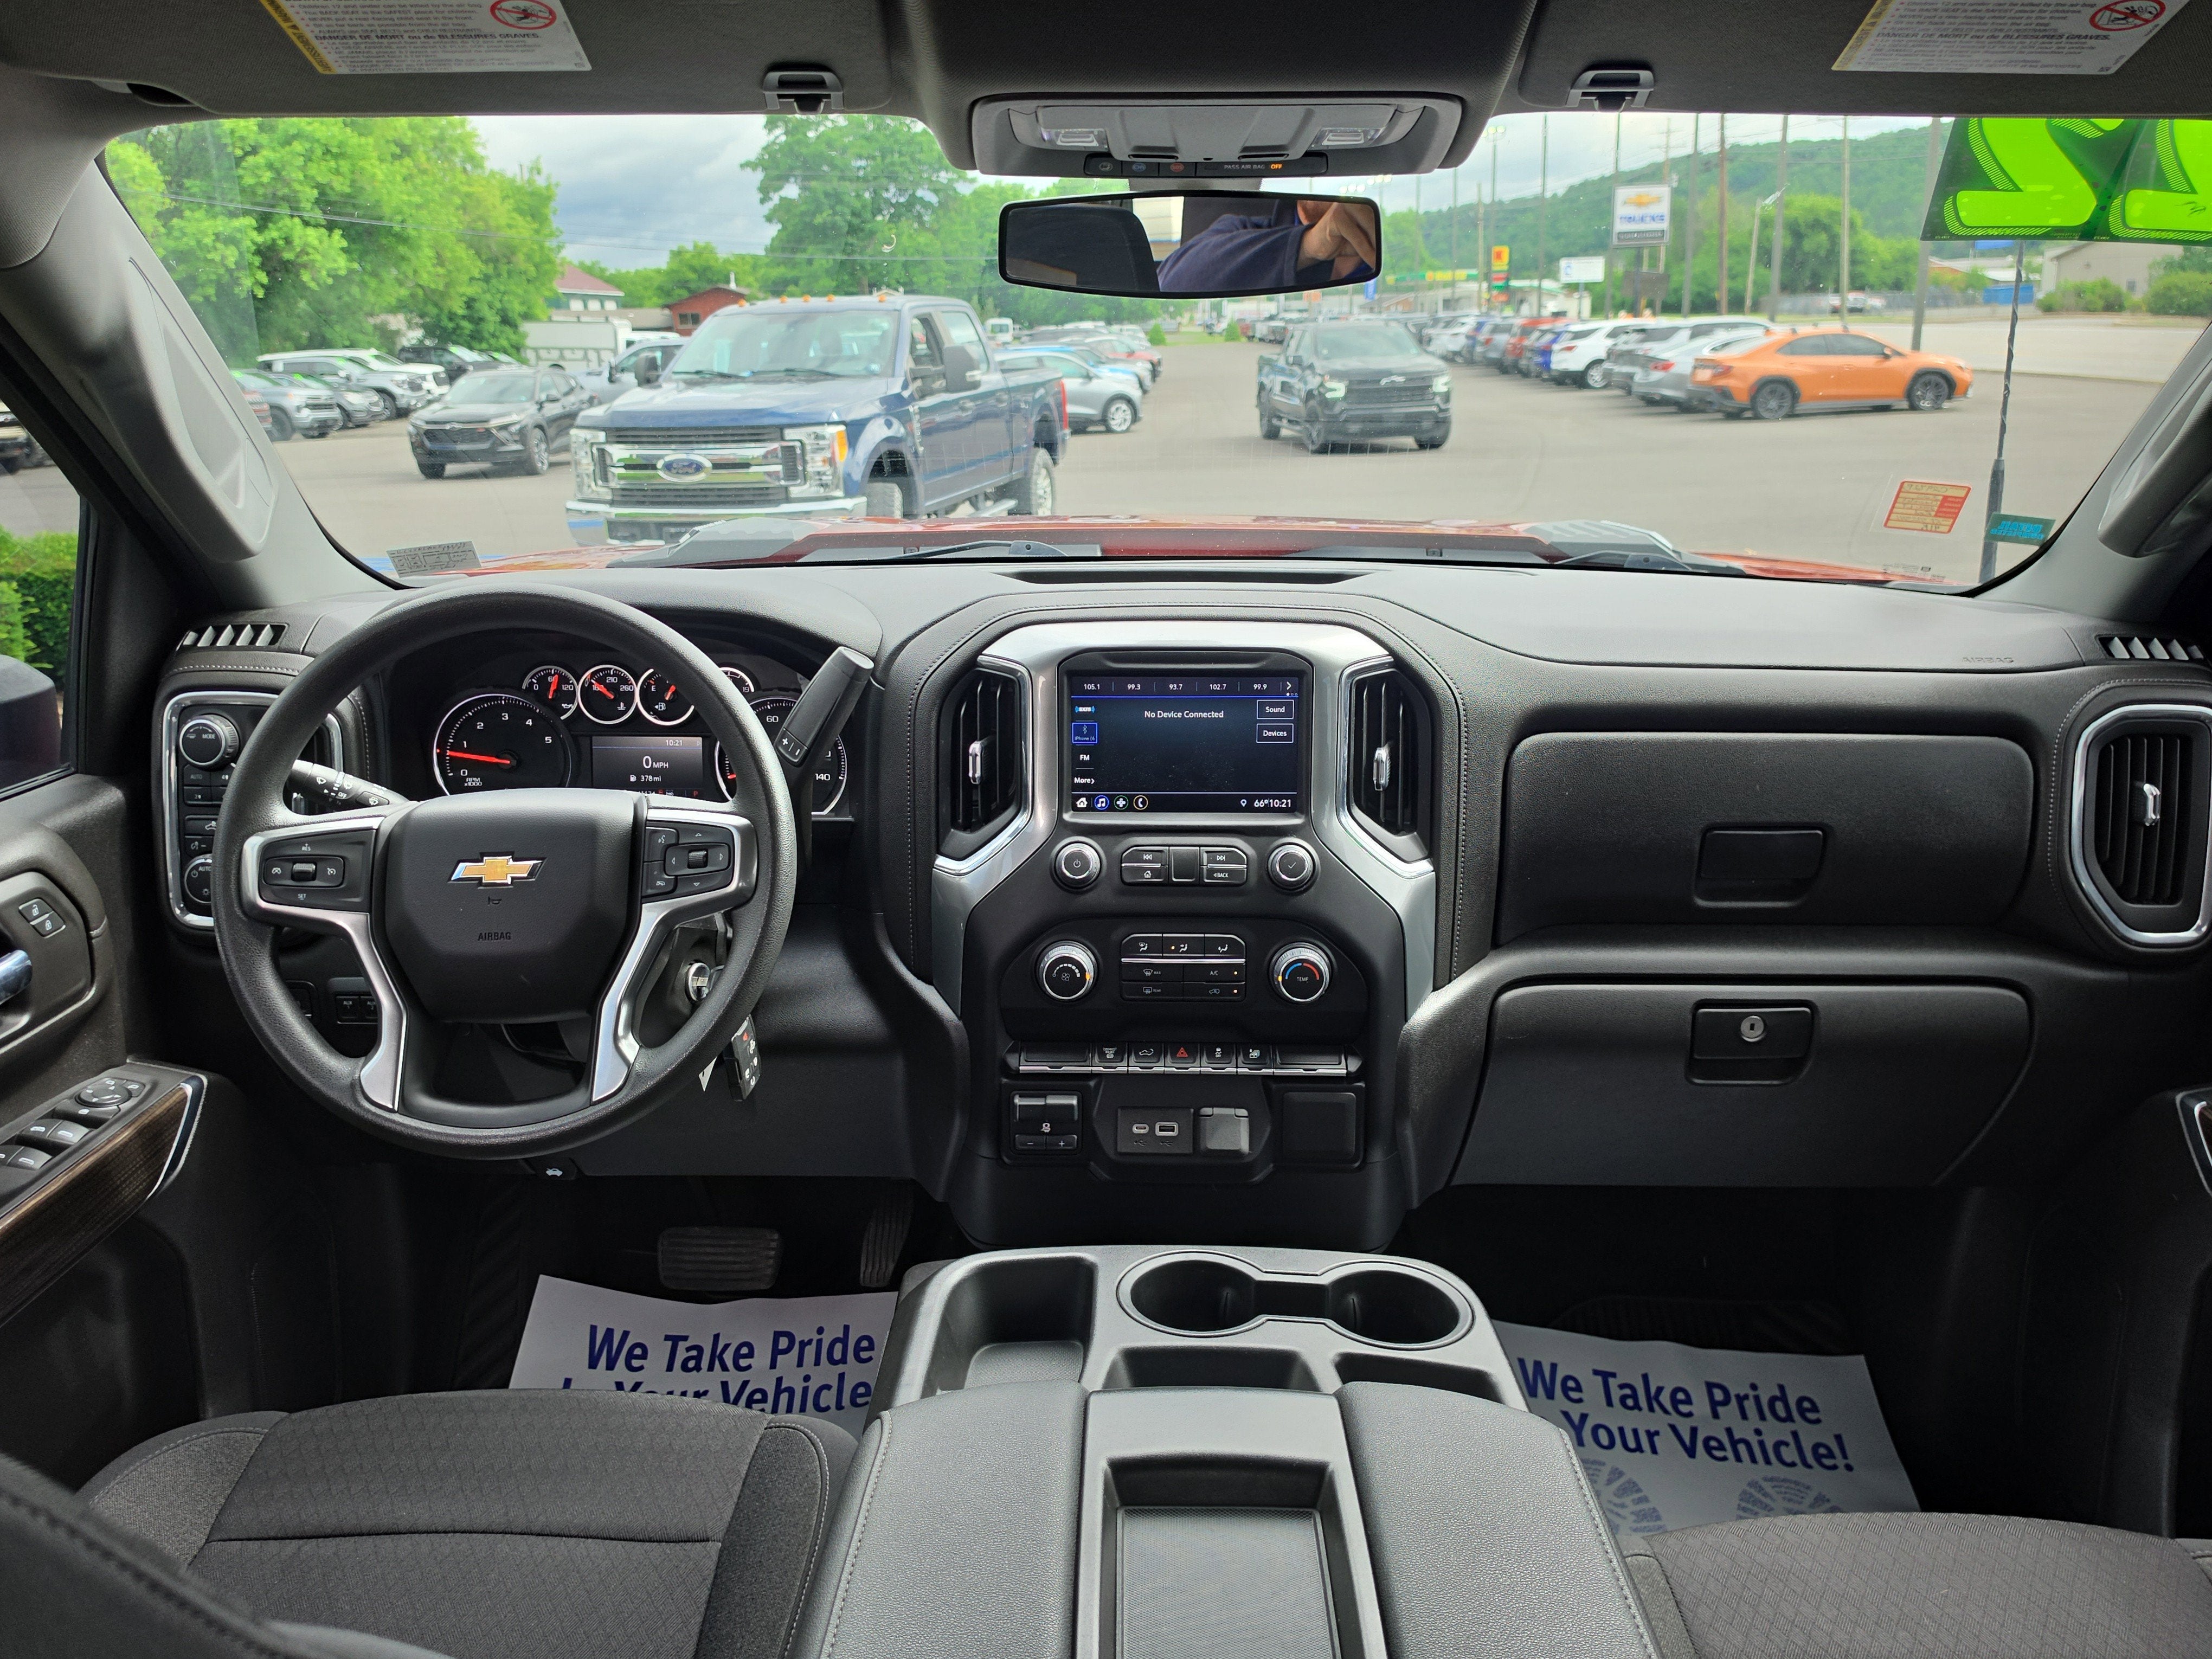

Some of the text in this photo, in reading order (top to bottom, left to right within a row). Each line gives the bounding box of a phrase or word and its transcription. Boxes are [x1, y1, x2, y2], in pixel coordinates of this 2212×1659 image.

[642, 755, 652, 769] 0
[1269, 799, 1291, 807] 10:21
[477, 931, 512, 941] AIRBAG
[588, 1324, 875, 1373] We Take Pride
[721, 1371, 872, 1414] Vehicle
[1518, 1357, 1823, 1425] We Take Pride
[1560, 1410, 1855, 1473] Your Vehicle!
